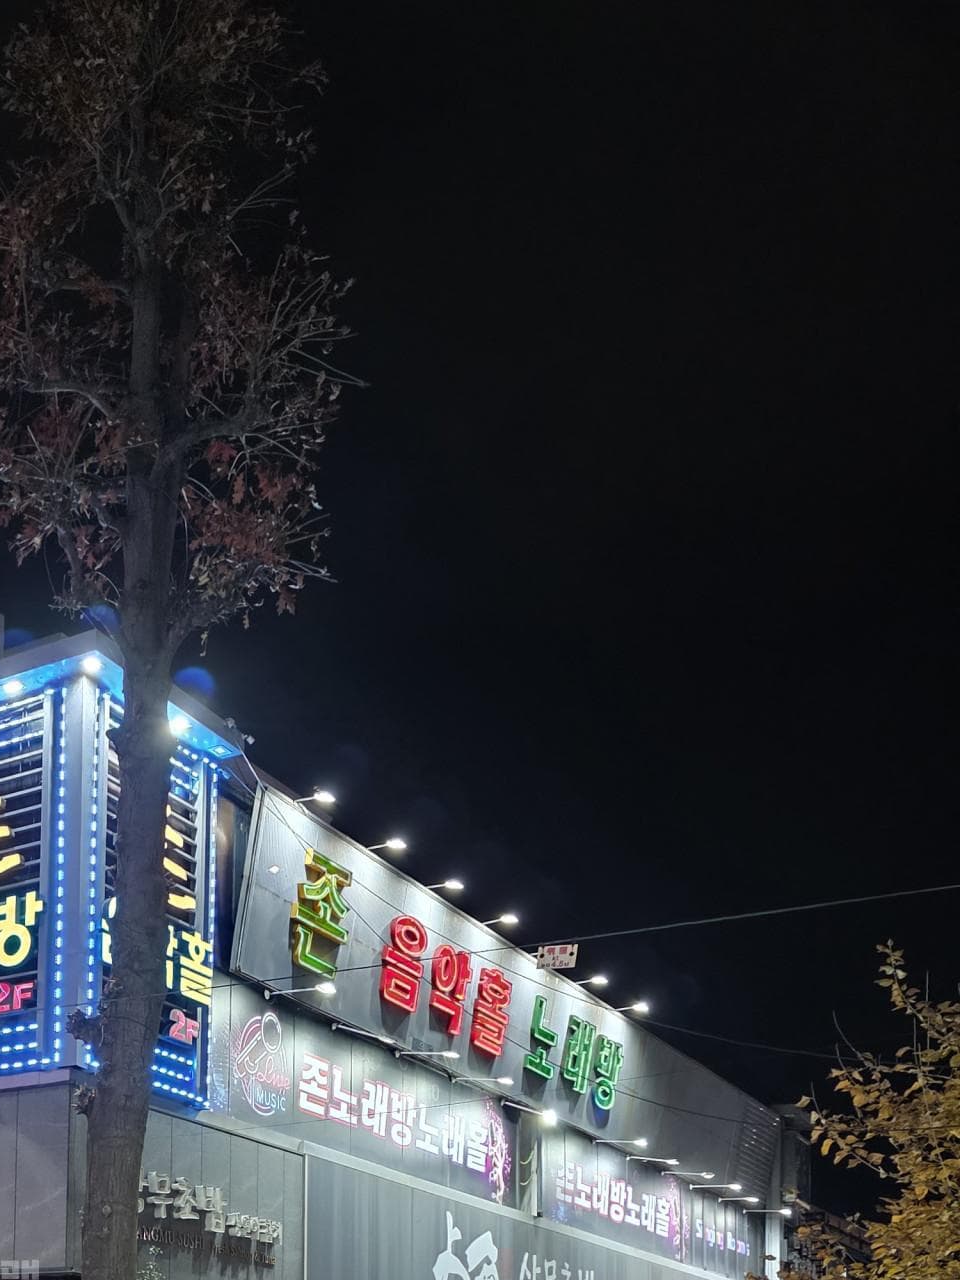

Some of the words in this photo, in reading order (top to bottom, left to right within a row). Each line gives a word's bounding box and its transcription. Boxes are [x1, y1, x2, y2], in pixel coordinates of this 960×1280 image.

[290, 848, 352, 980] 존
[380, 915, 512, 1058] 음악홀
[523, 995, 624, 1111] 노래방
[169, 1009, 199, 1044] 2F
[255, 1087, 286, 1112] MUSIC
[298, 1052, 490, 1174] 존노래방노래홀
[138, 1171, 228, 1233] 무초밥
[555, 1160, 670, 1238] 존노래방노래홀
